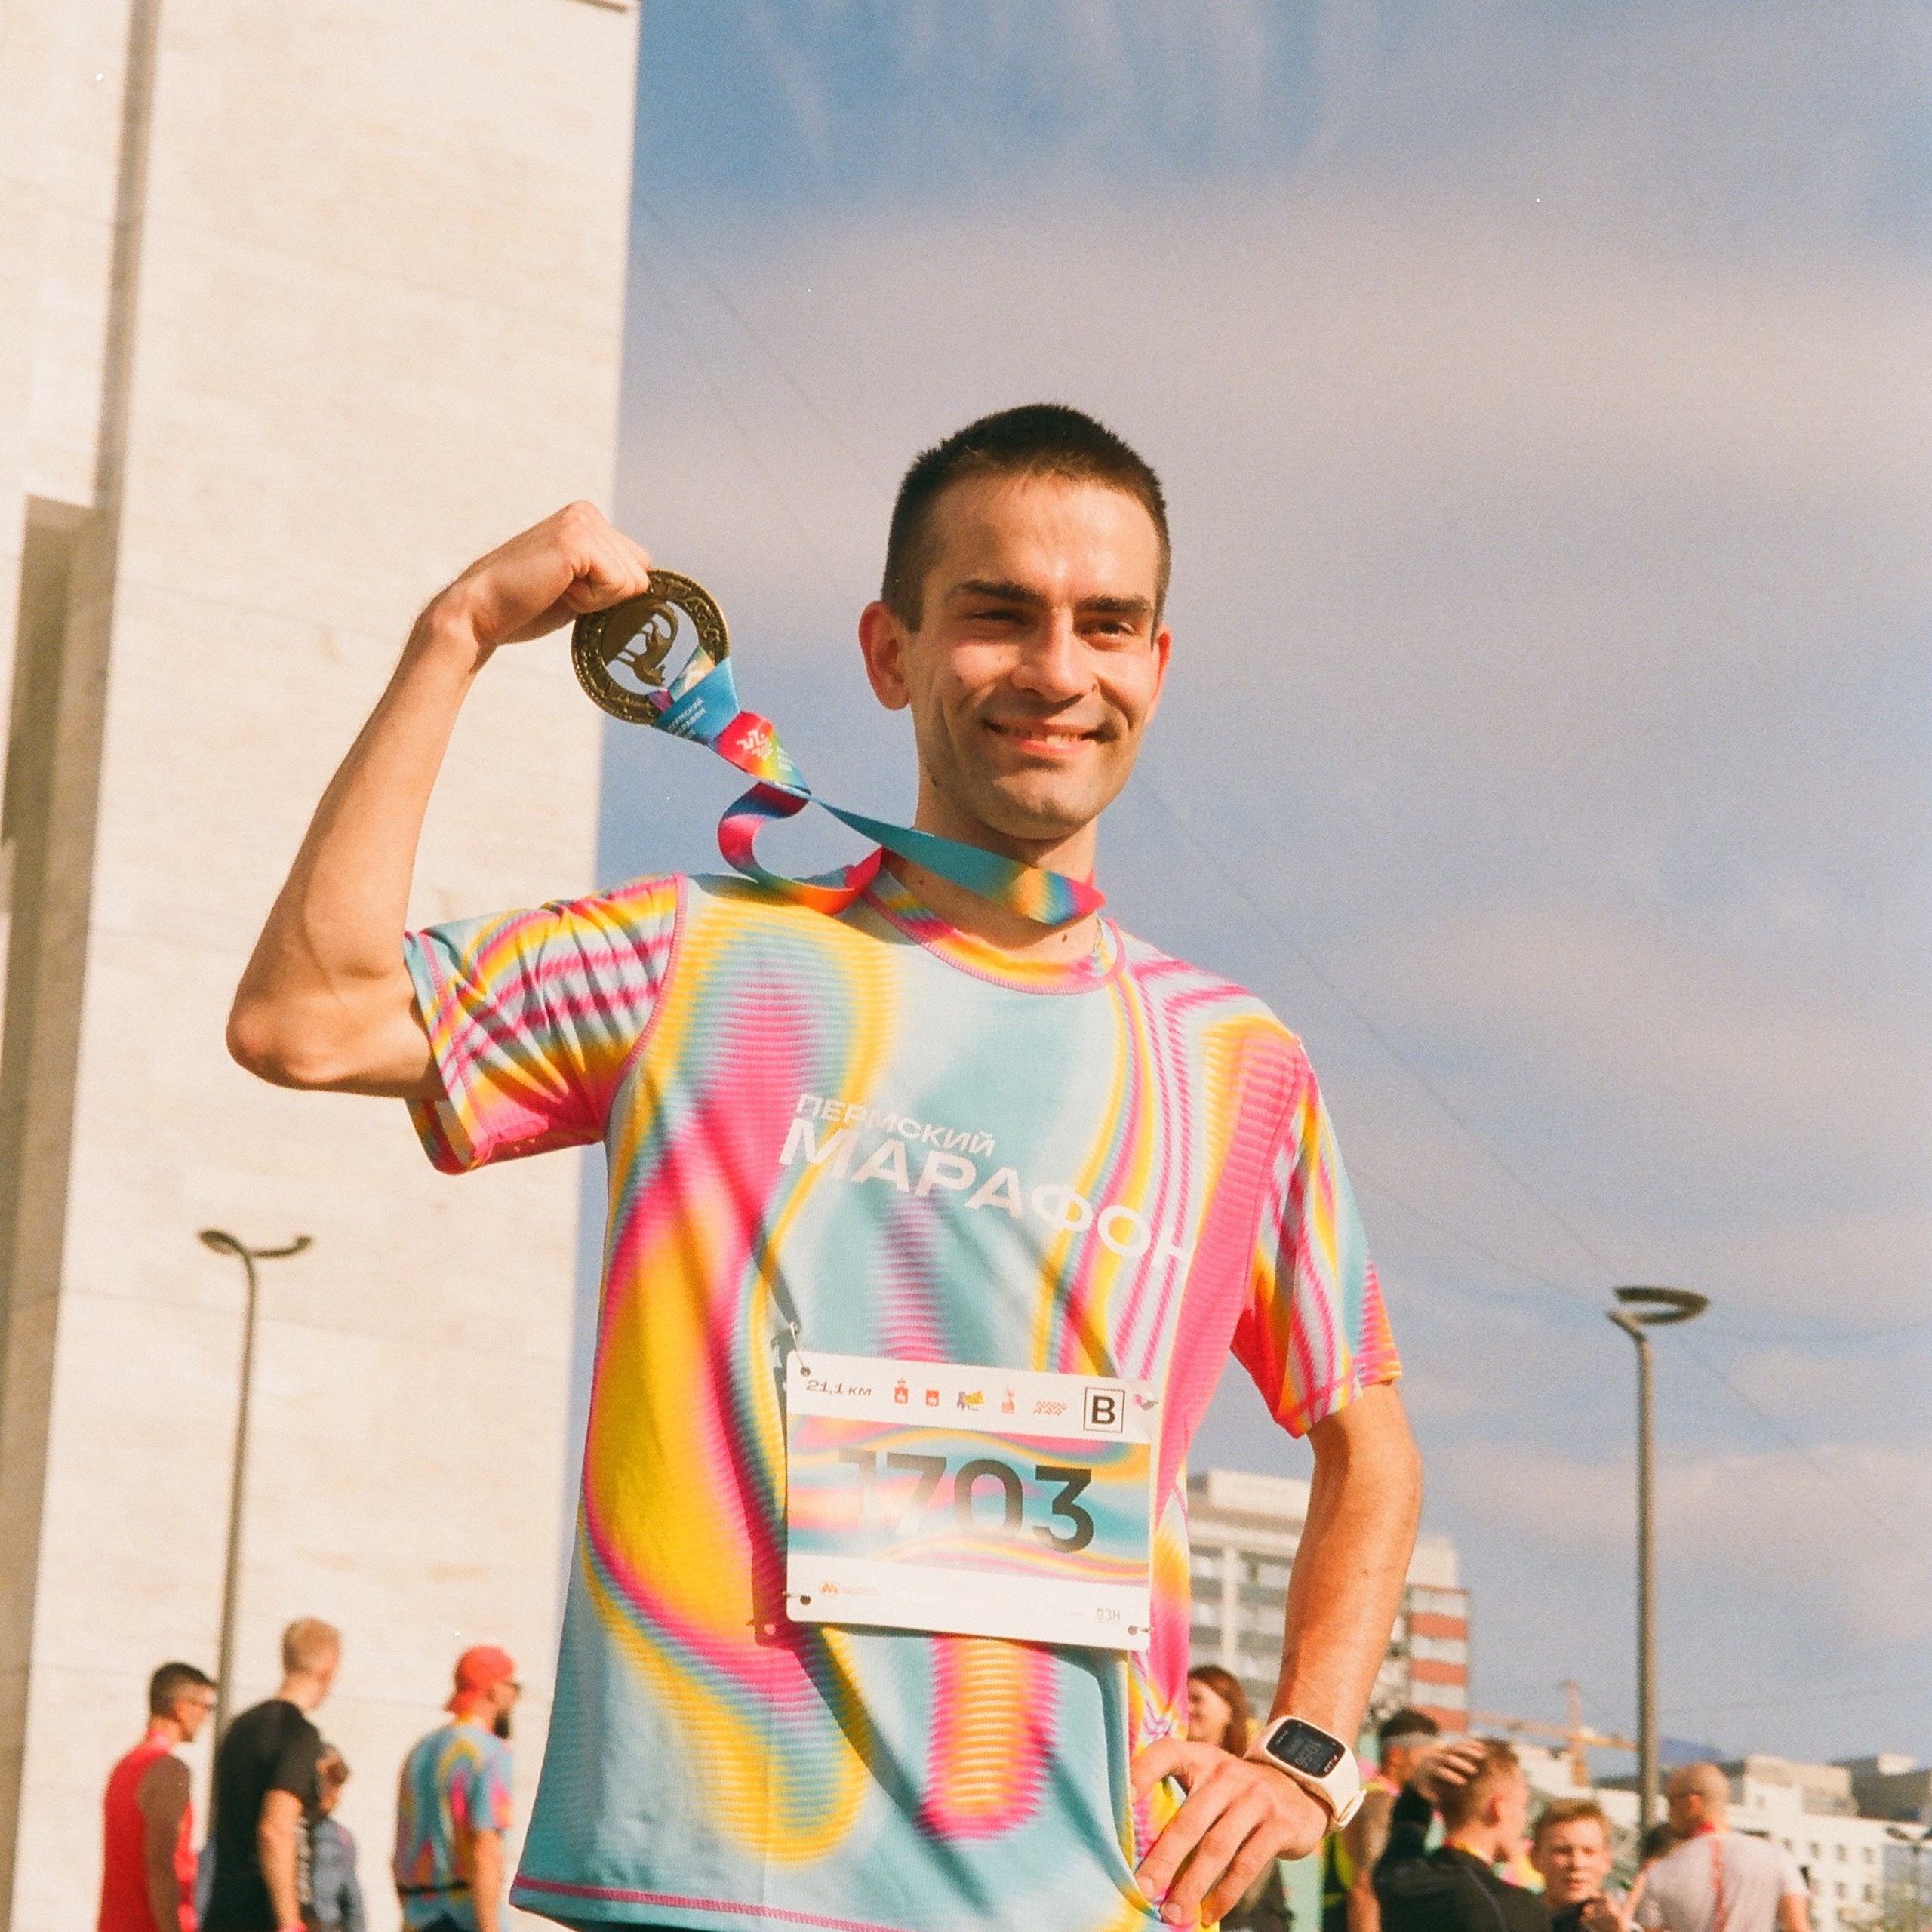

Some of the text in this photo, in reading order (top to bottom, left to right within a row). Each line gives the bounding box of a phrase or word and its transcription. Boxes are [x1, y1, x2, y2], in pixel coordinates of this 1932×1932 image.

[795, 1093, 996, 1158] ПЕРМСКИЙ
[778, 1118, 1196, 1272] МАРАФОН
[806, 1380, 844, 1396] 21,1
[838, 1447, 1095, 1553] 1703
